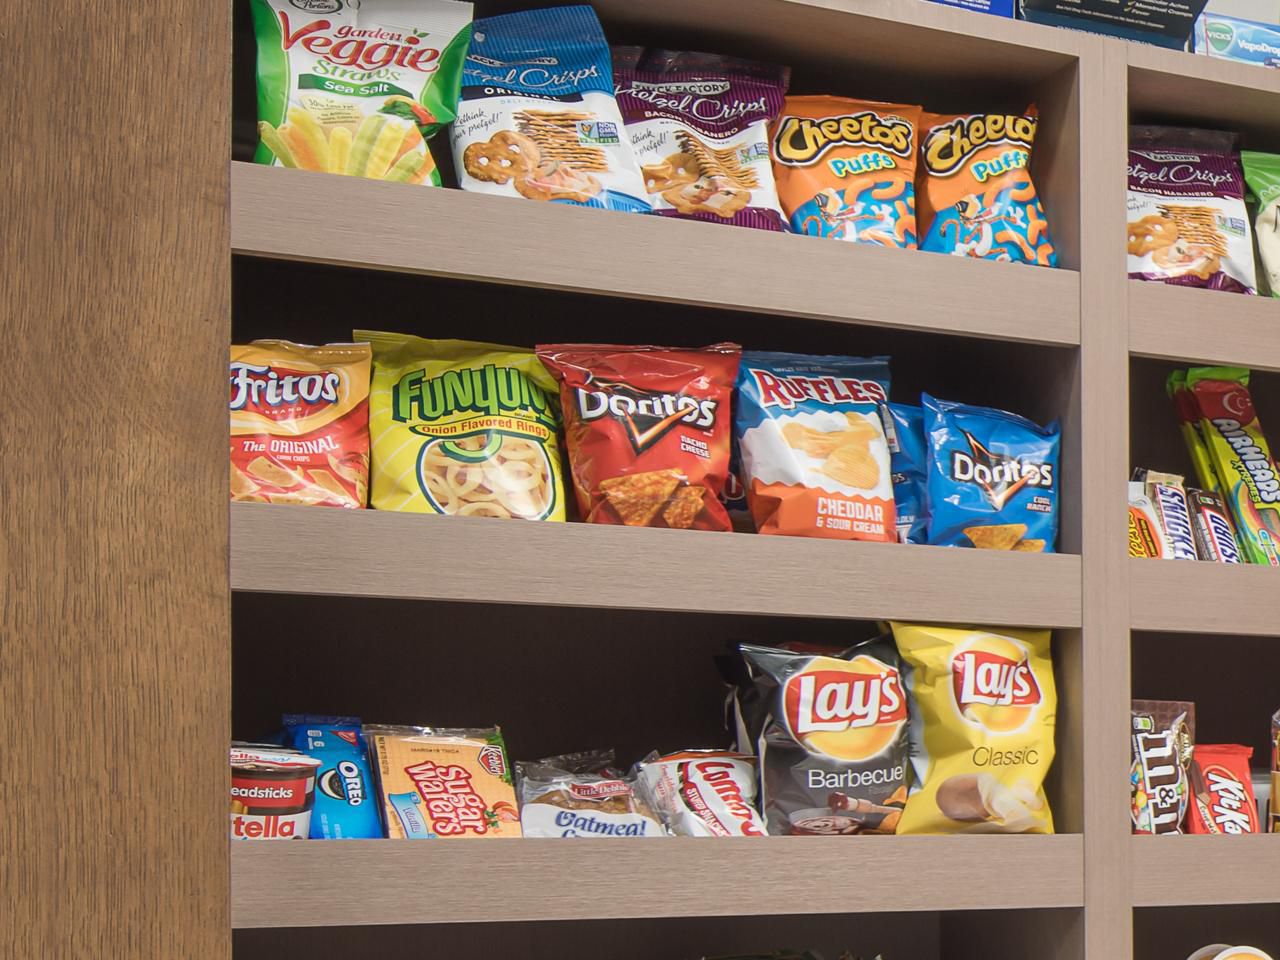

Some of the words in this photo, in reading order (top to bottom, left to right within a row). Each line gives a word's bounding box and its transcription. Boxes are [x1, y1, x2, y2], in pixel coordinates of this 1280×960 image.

[278, 9, 440, 73] Veggie
[323, 79, 353, 93] Sea
[355, 82, 390, 95] Salt
[775, 112, 912, 166] Cheetos
[831, 152, 896, 177] Puffs
[753, 367, 888, 408] RUFFLES
[577, 387, 718, 429] Doritos
[421, 423, 458, 436] Onion
[461, 417, 513, 432] Flavored
[242, 440, 266, 453] The
[270, 436, 339, 454] ORIGINAL
[816, 496, 885, 522] CHEDDAR
[815, 515, 824, 528] &
[825, 516, 851, 531] SOUR
[853, 519, 885, 535] CREAM
[798, 671, 900, 734] Lay's
[971, 747, 1040, 767] Classic
[337, 760, 363, 805] OREO
[808, 765, 904, 789] Barbecue
